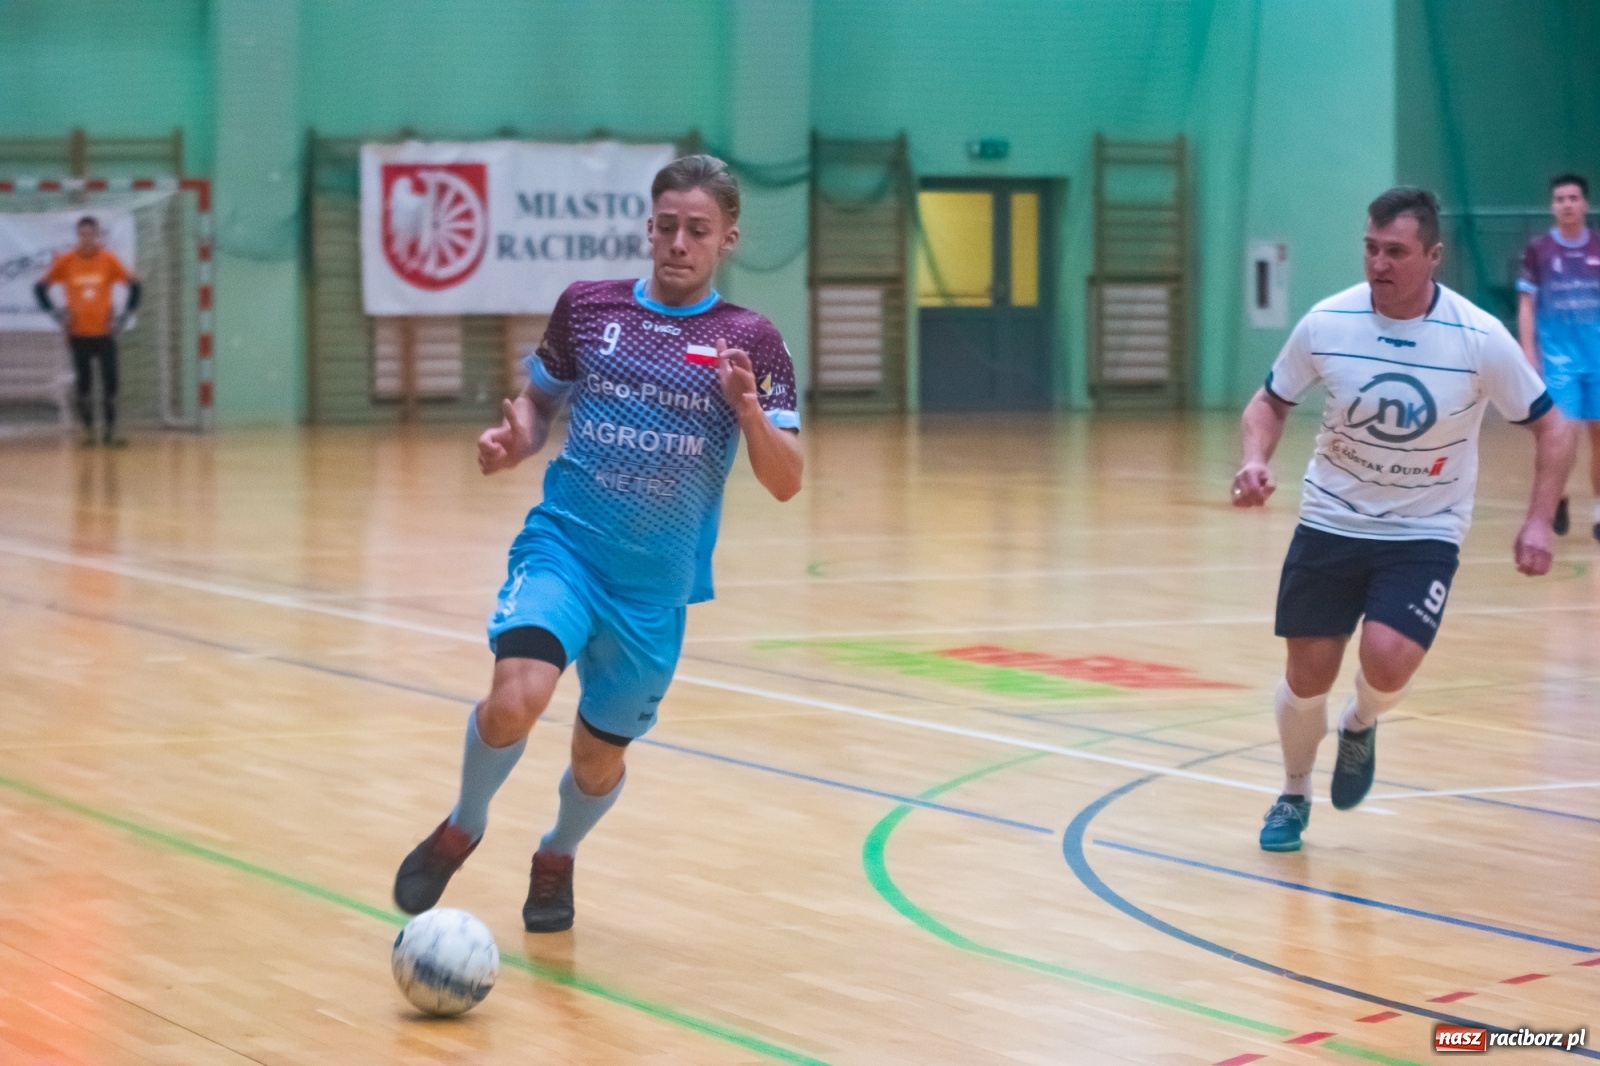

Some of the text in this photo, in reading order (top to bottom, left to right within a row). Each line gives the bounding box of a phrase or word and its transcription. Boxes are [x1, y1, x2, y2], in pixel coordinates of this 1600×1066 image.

[516, 192, 645, 220] MIASTO
[599, 322, 622, 356] 9
[586, 373, 712, 413] Geo-Punkt
[580, 419, 706, 456] AGROTIM
[595, 470, 677, 497] KIETRZ
[1423, 580, 1447, 615] 9
